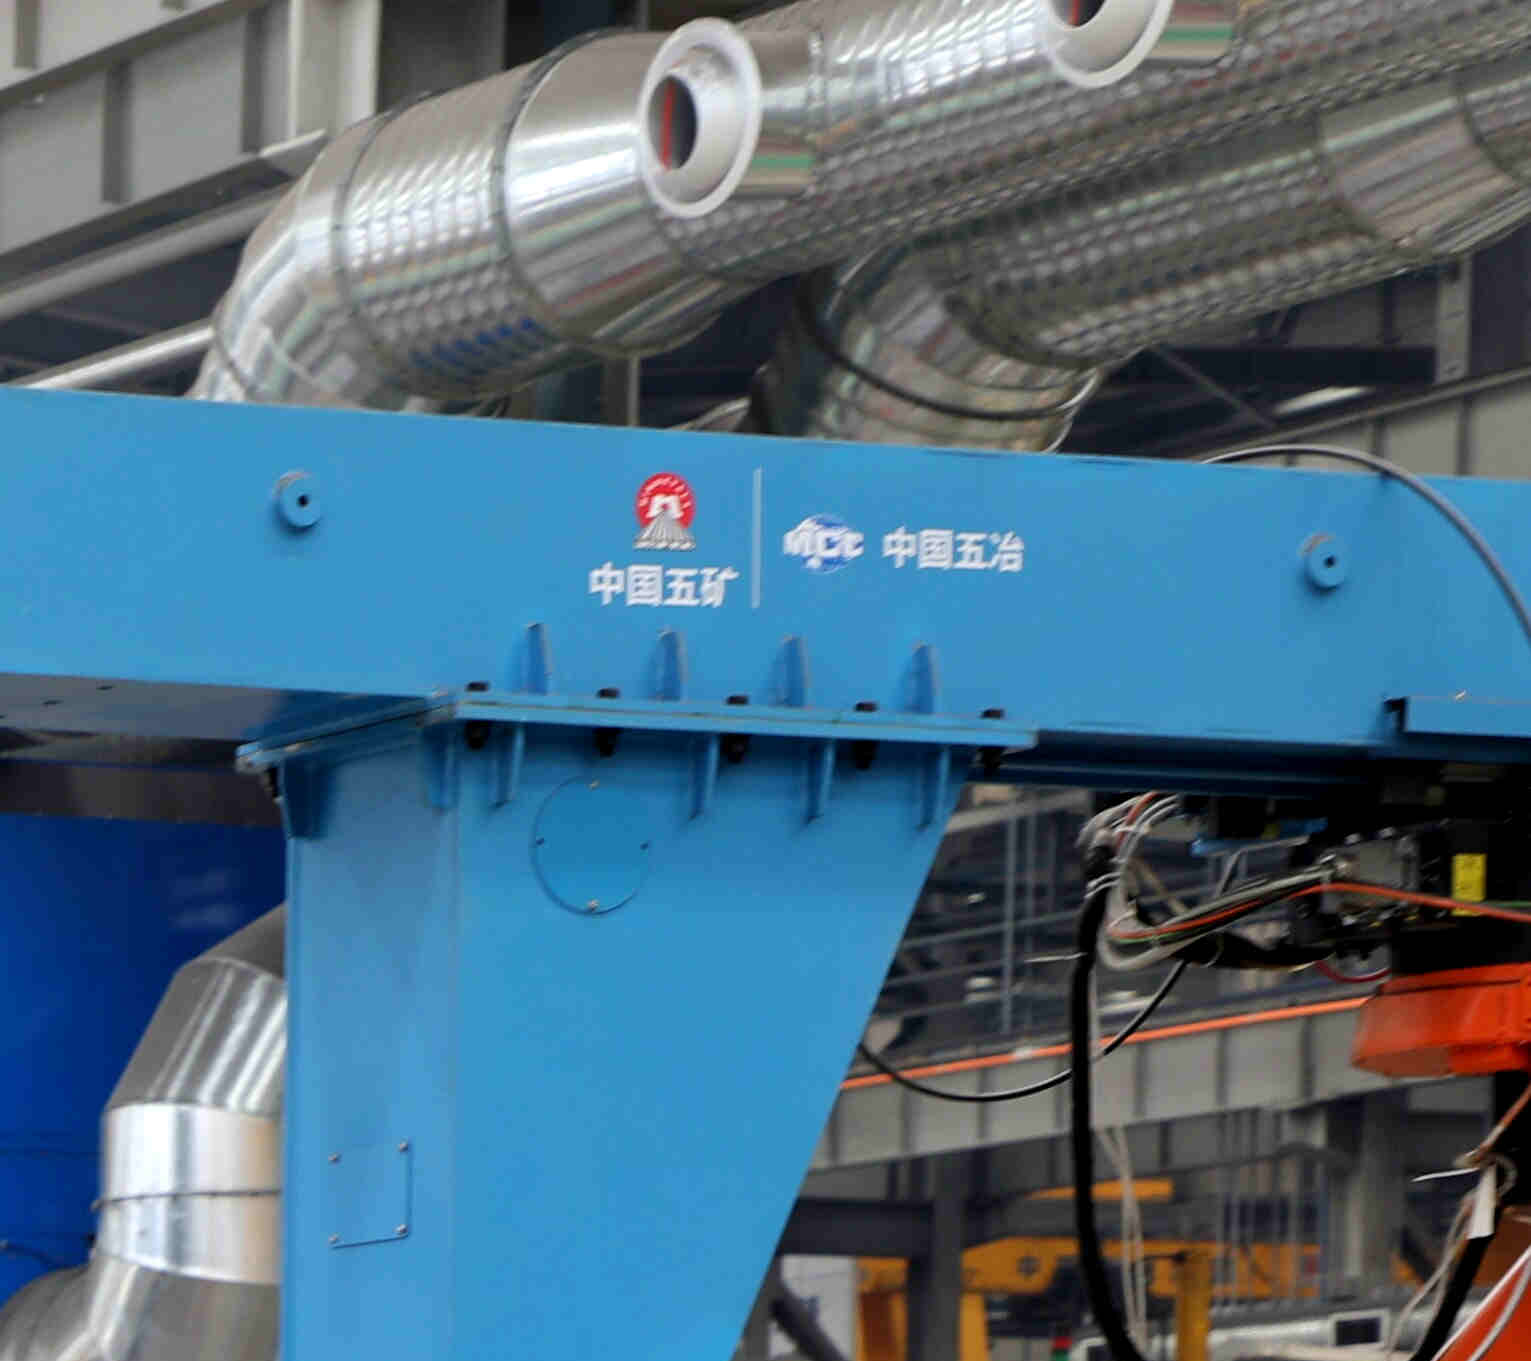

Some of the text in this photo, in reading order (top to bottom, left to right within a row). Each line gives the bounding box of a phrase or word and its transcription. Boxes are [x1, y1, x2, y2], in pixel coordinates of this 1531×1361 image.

[881, 526, 1025, 573] 中国五冶
[589, 561, 740, 608] 中国五矿
